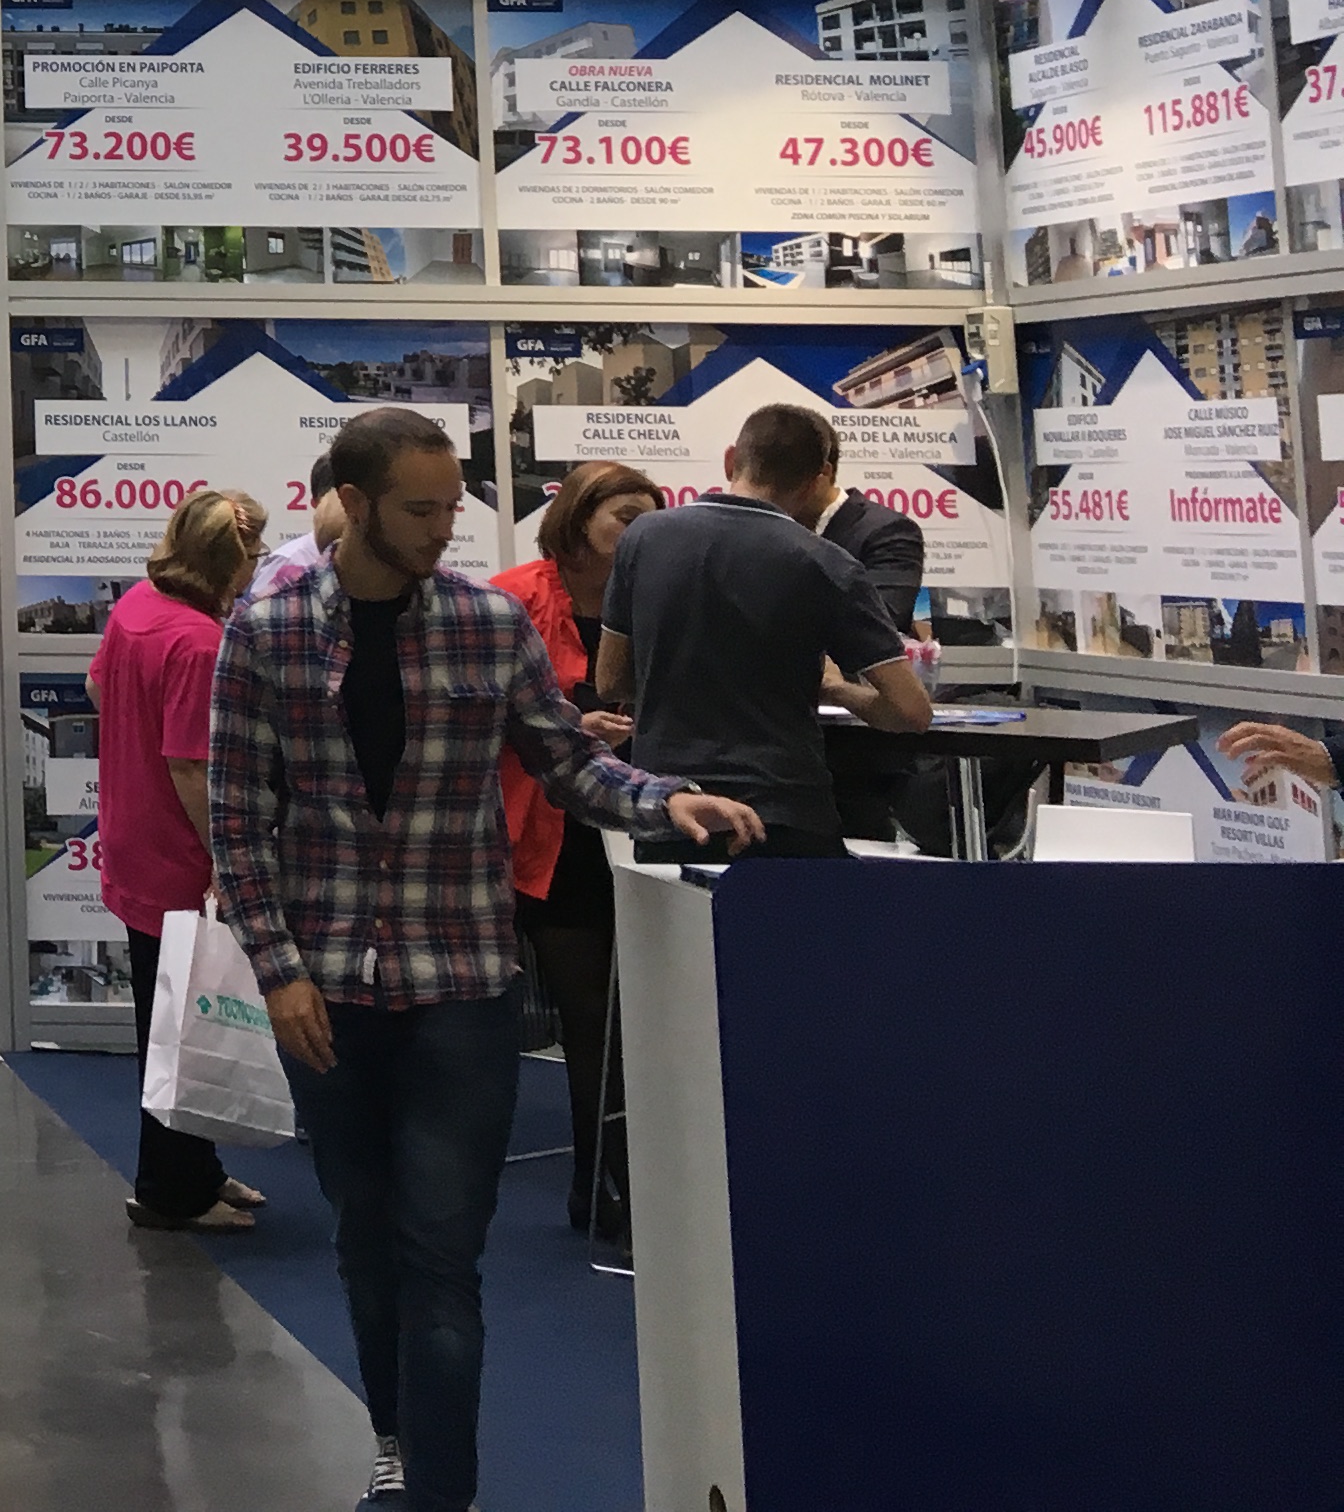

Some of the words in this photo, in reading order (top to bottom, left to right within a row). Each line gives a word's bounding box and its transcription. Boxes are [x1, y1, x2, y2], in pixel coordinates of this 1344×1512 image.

[1190, 12, 1244, 36] ZARABANDA
[32, 60, 116, 73] PROMOCIÓN
[119, 62, 136, 73] EN
[139, 62, 205, 73] PAIPORTA
[293, 63, 351, 75] EDIFICIO
[354, 63, 420, 75] FERRERES
[568, 65, 605, 77] OBRA
[608, 65, 653, 77] NUEVA
[79, 77, 109, 89] Calle
[112, 77, 158, 91] Picanya
[293, 78, 343, 90] Avenida
[346, 78, 421, 90] Treballadors
[775, 74, 862, 86] RESIDENCIAL
[869, 74, 931, 86] MOLINET
[549, 80, 591, 92] CALLE
[594, 80, 674, 93] FALCONERA
[63, 92, 115, 106] Paiporta
[124, 92, 175, 104] Valencia
[361, 94, 412, 106] Valencia
[801, 89, 845, 101] Rótova
[855, 90, 907, 102] Valencia
[610, 96, 669, 108] Castellón
[1143, 84, 1250, 136] 115.881€
[105, 115, 133, 123] DESDE
[343, 117, 372, 125] DESDE
[598, 119, 627, 128] DESDE
[840, 121, 870, 129] DESDE
[1023, 115, 1103, 159] 45.900€
[44, 131, 196, 161] 73.200€
[283, 132, 436, 163] 39.500€
[537, 136, 691, 165] 73.100€
[779, 137, 935, 167] 47.300€
[20, 334, 48, 346] GFA
[517, 339, 545, 351] GFA
[44, 414, 132, 426] RESIDENCIAL
[135, 415, 160, 426] LOS
[164, 415, 217, 427] LLANOS
[586, 413, 675, 424] RESIDENCIAL
[832, 415, 921, 427] RESIDENCIAL
[103, 430, 160, 442] Castellón
[582, 428, 625, 440] CALLE
[628, 428, 681, 441] CHELVA
[861, 431, 880, 443] DE
[882, 431, 901, 443] LA
[903, 431, 958, 444] MUSICA
[574, 444, 627, 456] Torrente
[637, 445, 690, 457] Valencia
[888, 448, 942, 459] Valencia
[117, 462, 146, 471] DESDE
[864, 472, 893, 480] DESDE
[1049, 489, 1130, 521] 55.481€
[1169, 486, 1283, 524] Infórmate
[23, 555, 74, 564] RESIDENCIAL
[30, 690, 59, 703] GFA
